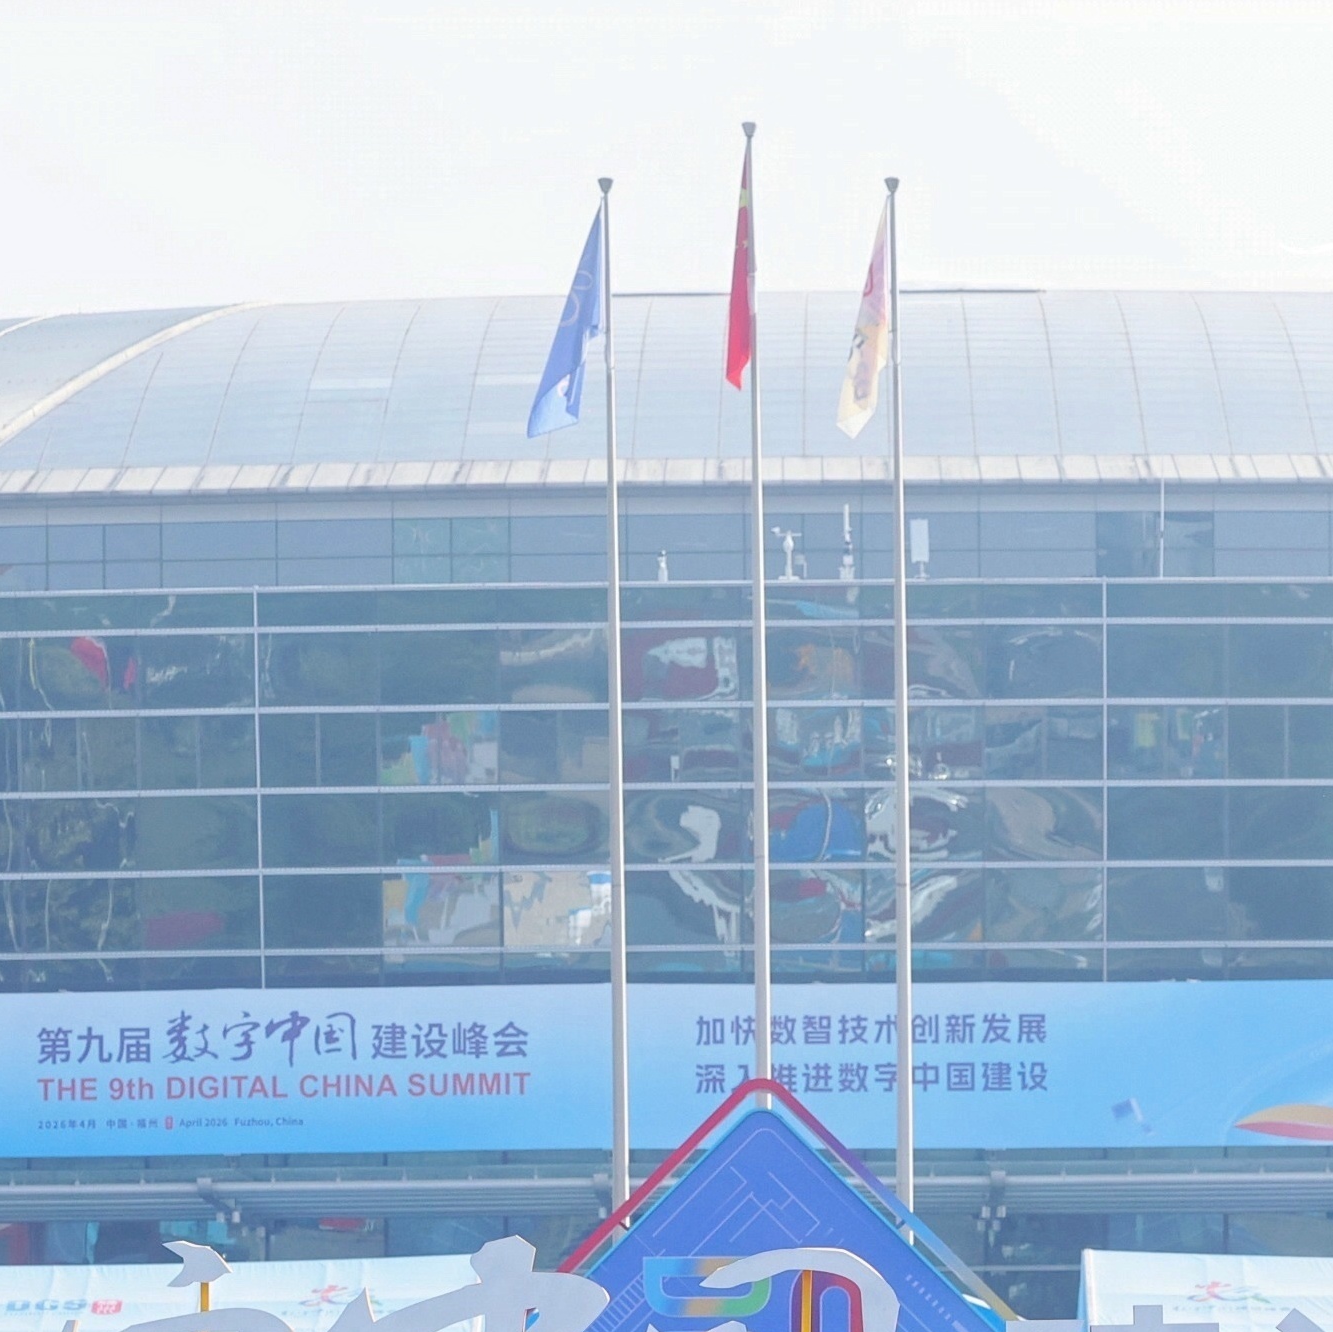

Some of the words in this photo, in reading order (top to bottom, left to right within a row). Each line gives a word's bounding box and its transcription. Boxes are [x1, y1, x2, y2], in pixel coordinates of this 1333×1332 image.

[37, 1078, 98, 1101] THE
[109, 1077, 154, 1101] 9th
[166, 1075, 288, 1099] DIGITAL
[299, 1073, 398, 1098] CHINA
[408, 1072, 531, 1097] SUMMIT
[179, 1117, 203, 1129] April
[205, 1117, 228, 1127] 2026
[276, 1116, 303, 1127] China
